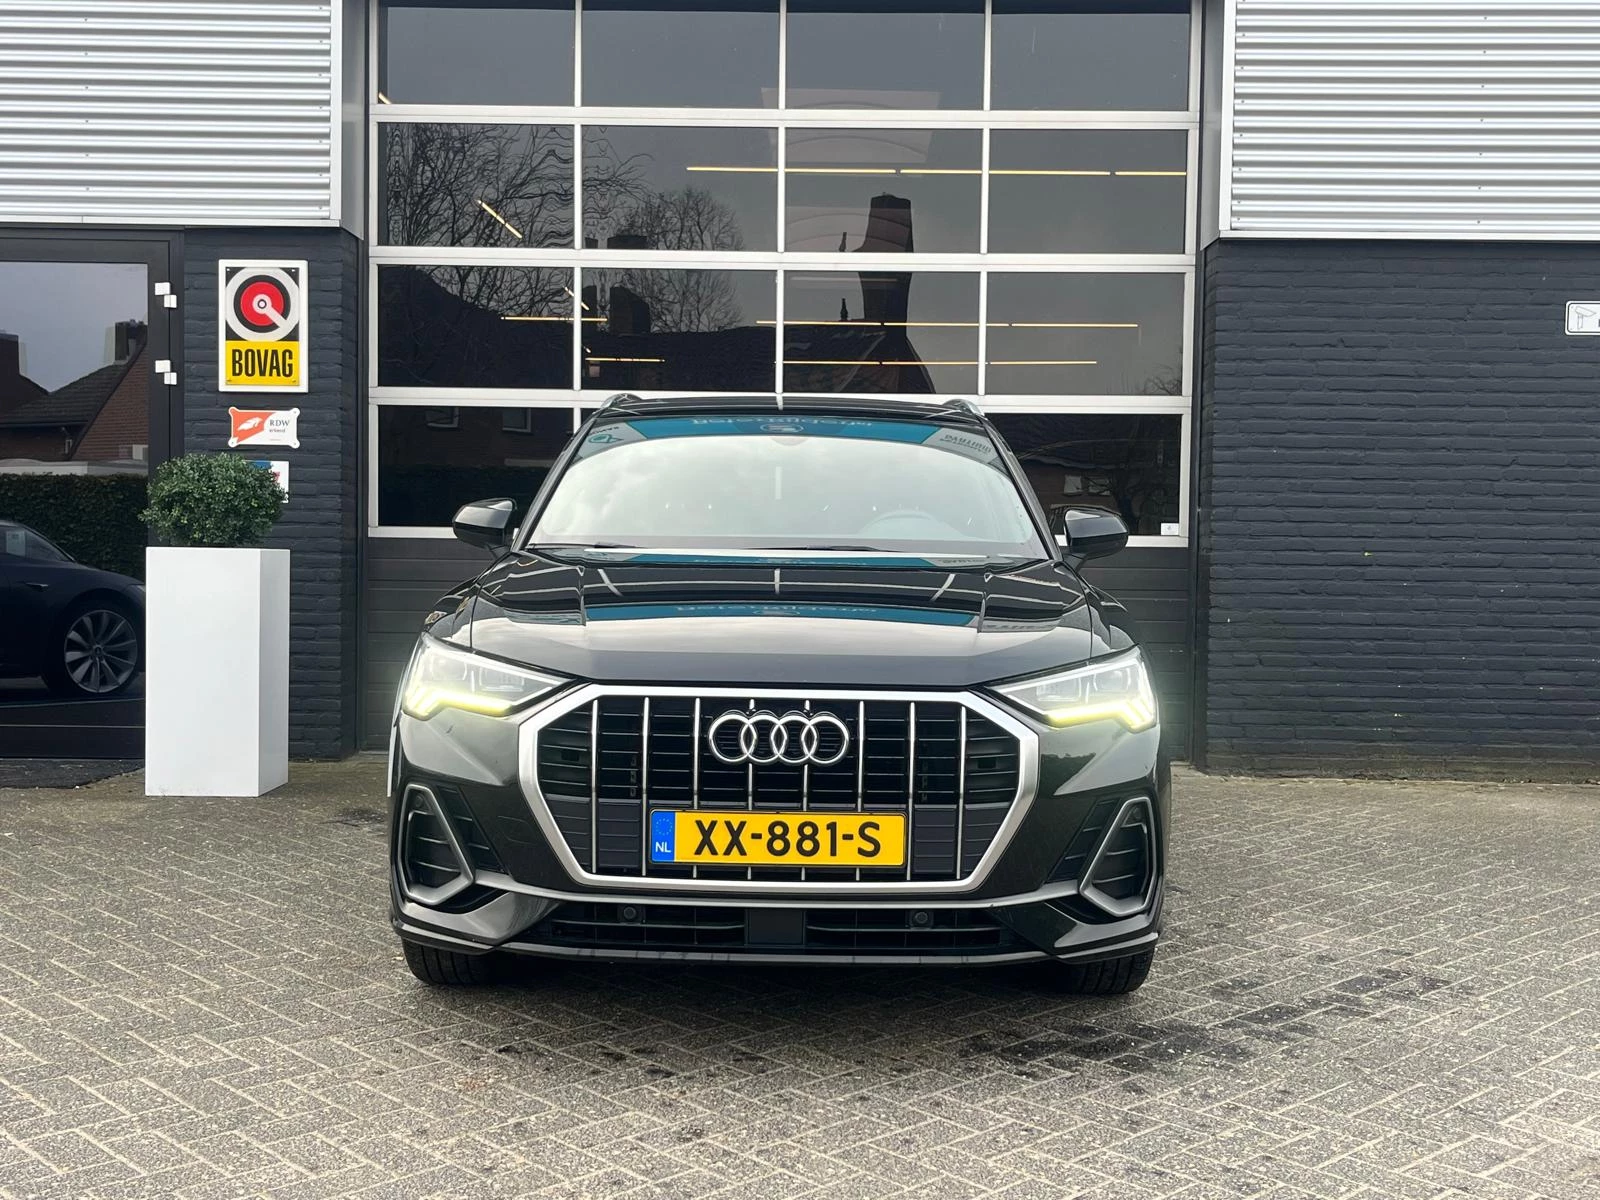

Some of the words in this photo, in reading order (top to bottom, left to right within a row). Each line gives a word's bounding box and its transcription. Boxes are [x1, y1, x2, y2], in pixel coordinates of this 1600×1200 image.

[232, 348, 293, 378] BOVAG
[269, 419, 290, 427] RDW
[655, 842, 671, 853] NL
[694, 819, 881, 858] XX-881-S
